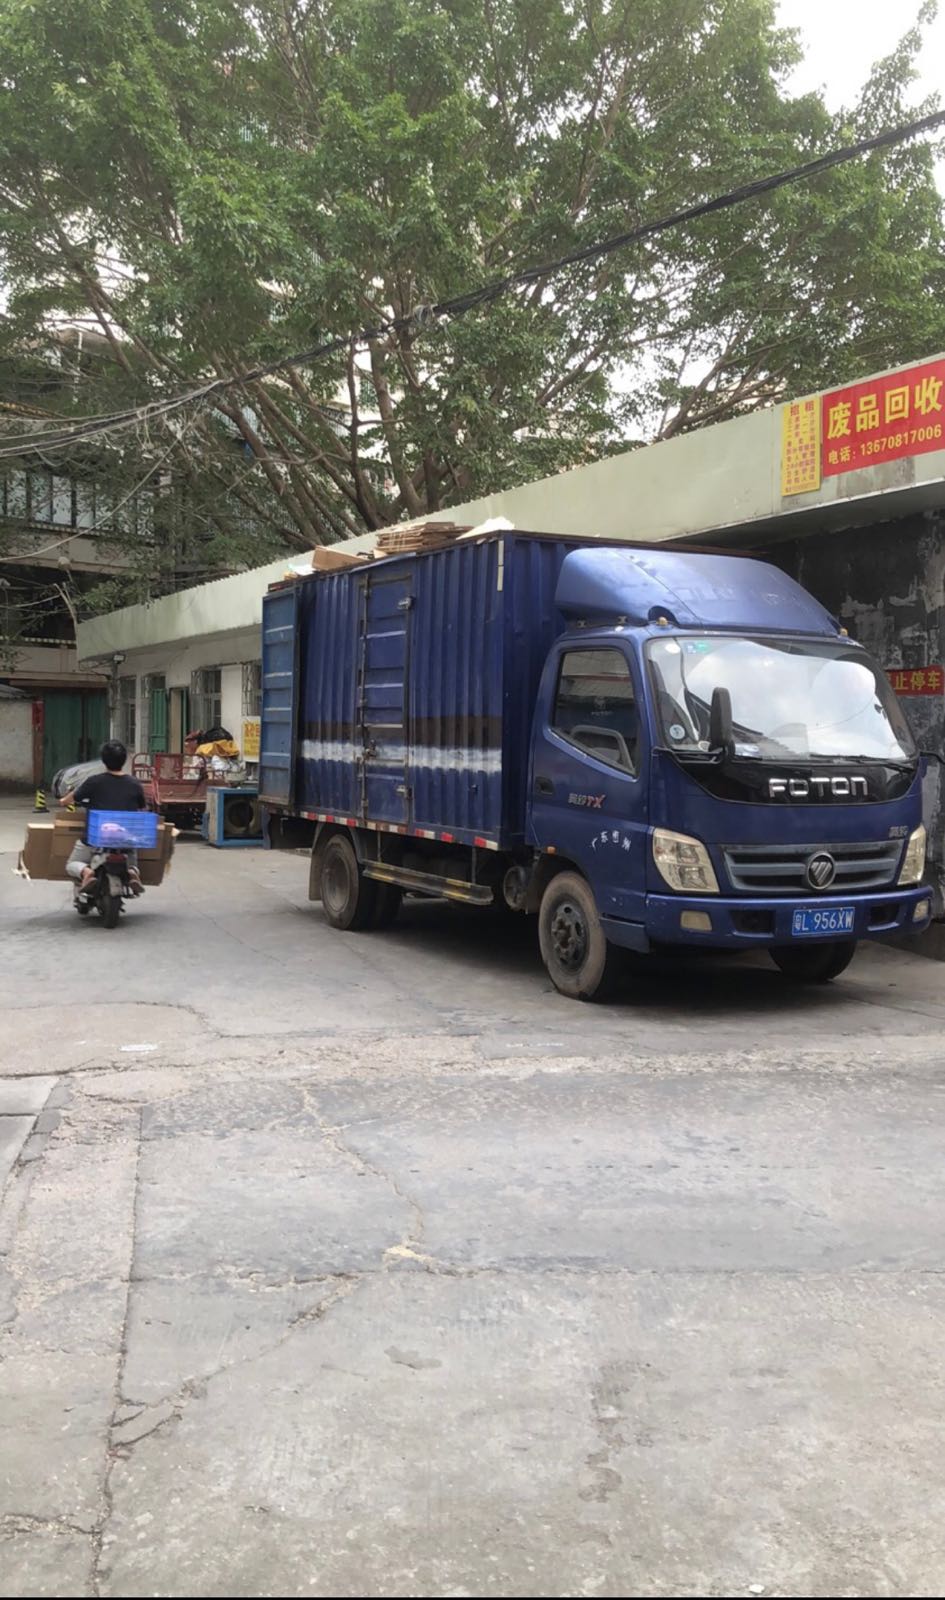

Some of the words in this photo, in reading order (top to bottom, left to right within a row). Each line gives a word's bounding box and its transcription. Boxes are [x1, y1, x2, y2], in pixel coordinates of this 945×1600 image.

[827, 376, 943, 440] 废品回收
[769, 776, 868, 798] FOTON
